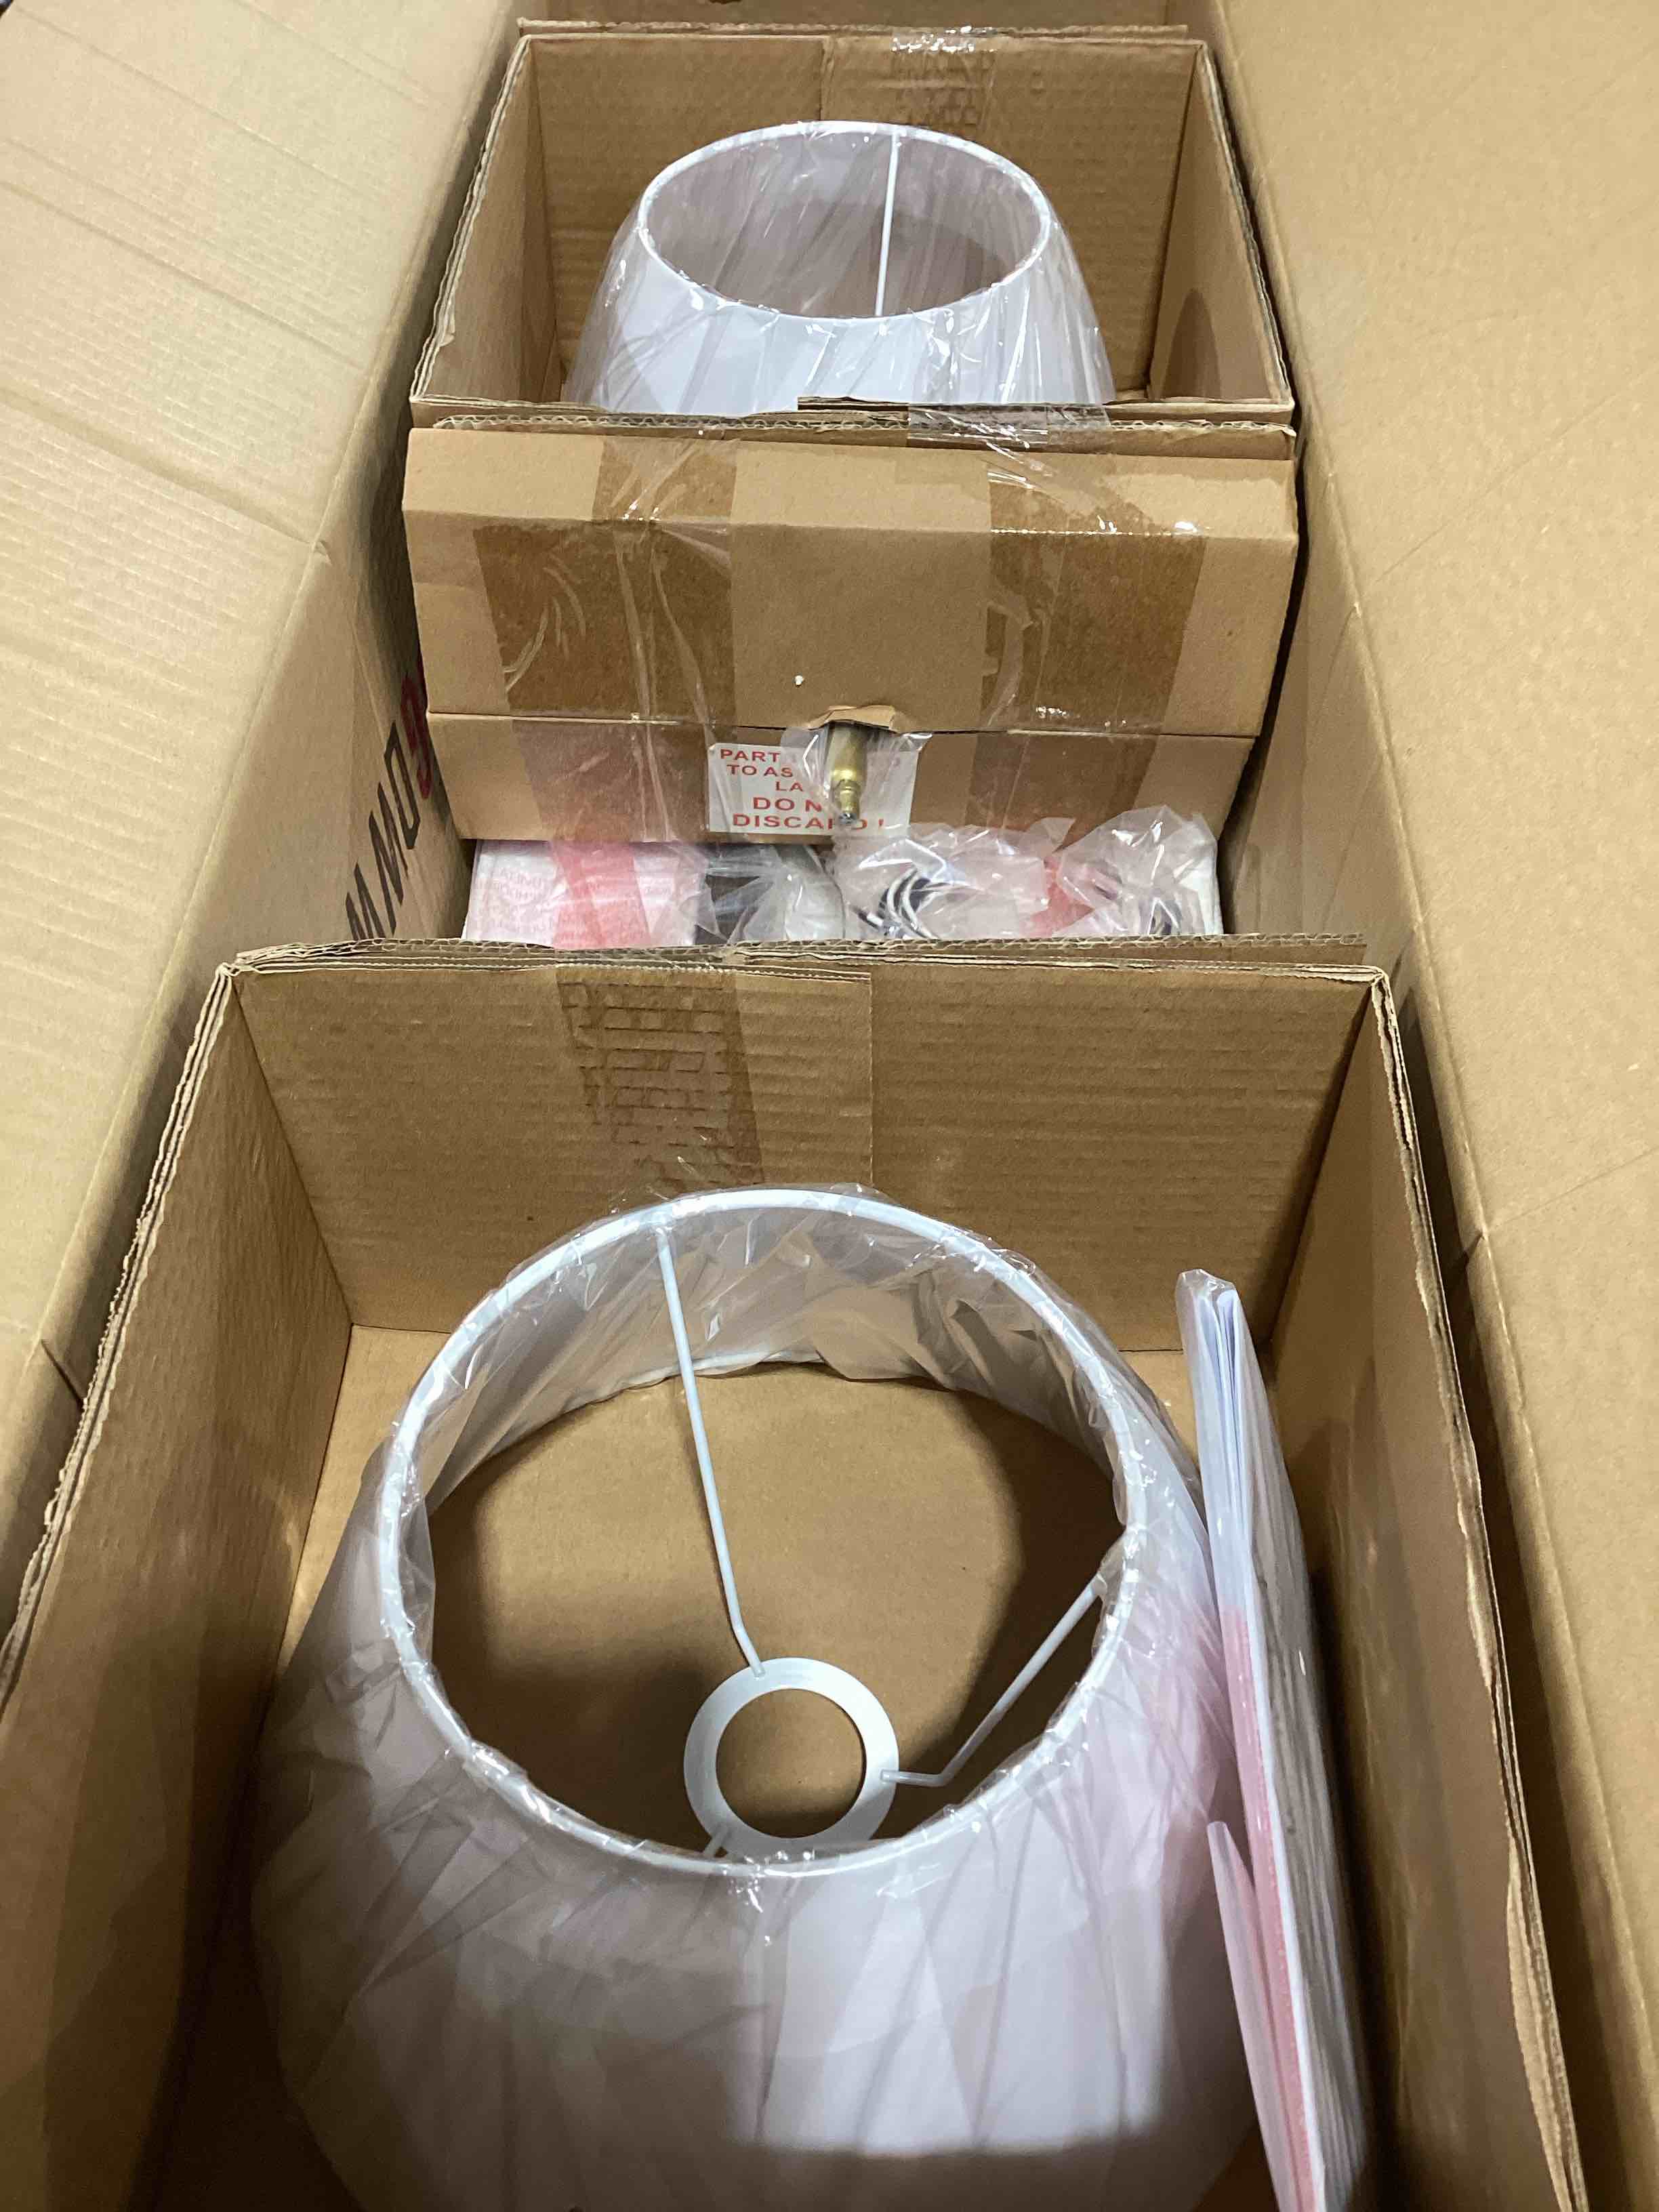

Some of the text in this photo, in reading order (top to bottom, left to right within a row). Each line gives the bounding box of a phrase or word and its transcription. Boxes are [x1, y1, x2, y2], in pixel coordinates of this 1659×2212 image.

[726, 764, 757, 776] TO
[776, 781, 804, 792] LA
[753, 797, 795, 811] DO
